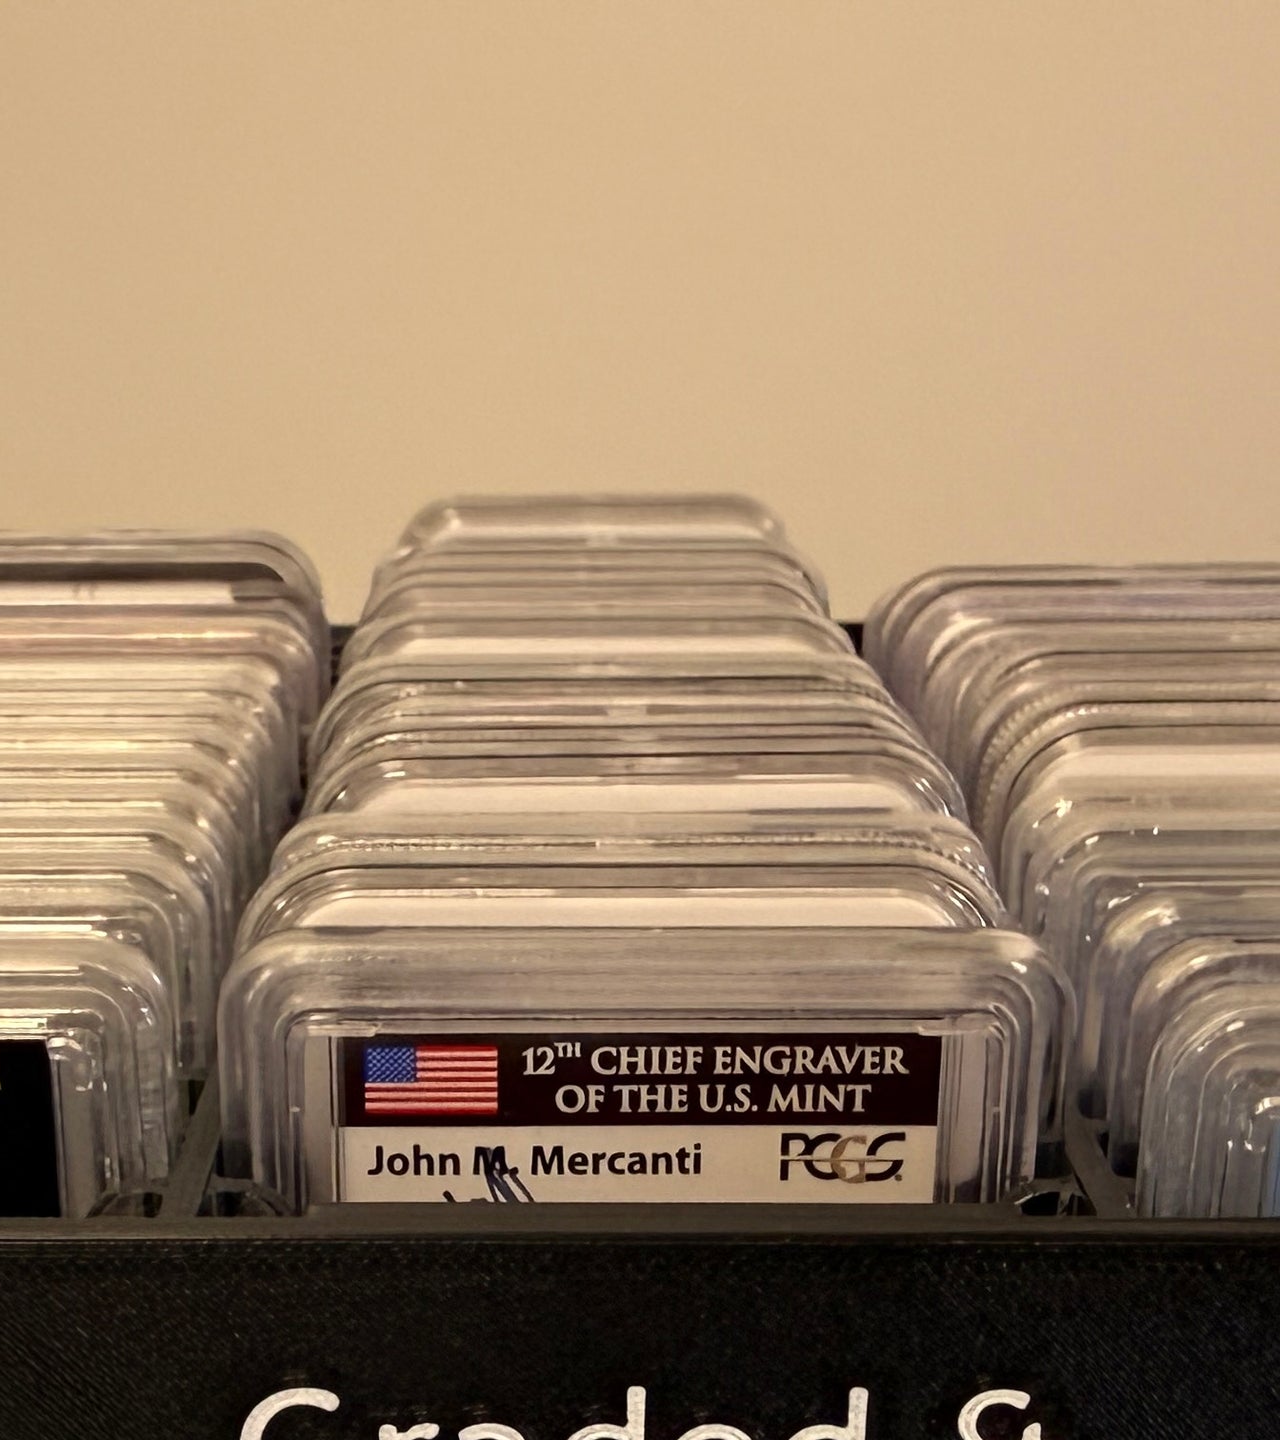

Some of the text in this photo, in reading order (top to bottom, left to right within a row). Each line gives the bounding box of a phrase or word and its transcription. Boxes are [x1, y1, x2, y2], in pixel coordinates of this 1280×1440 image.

[590, 1046, 702, 1076] CHIEF
[714, 1045, 910, 1076] ENGRAVER
[555, 1084, 872, 1114] OF THE U.S. MINT
[367, 1144, 461, 1176] John
[531, 1142, 702, 1175] Mercanti
